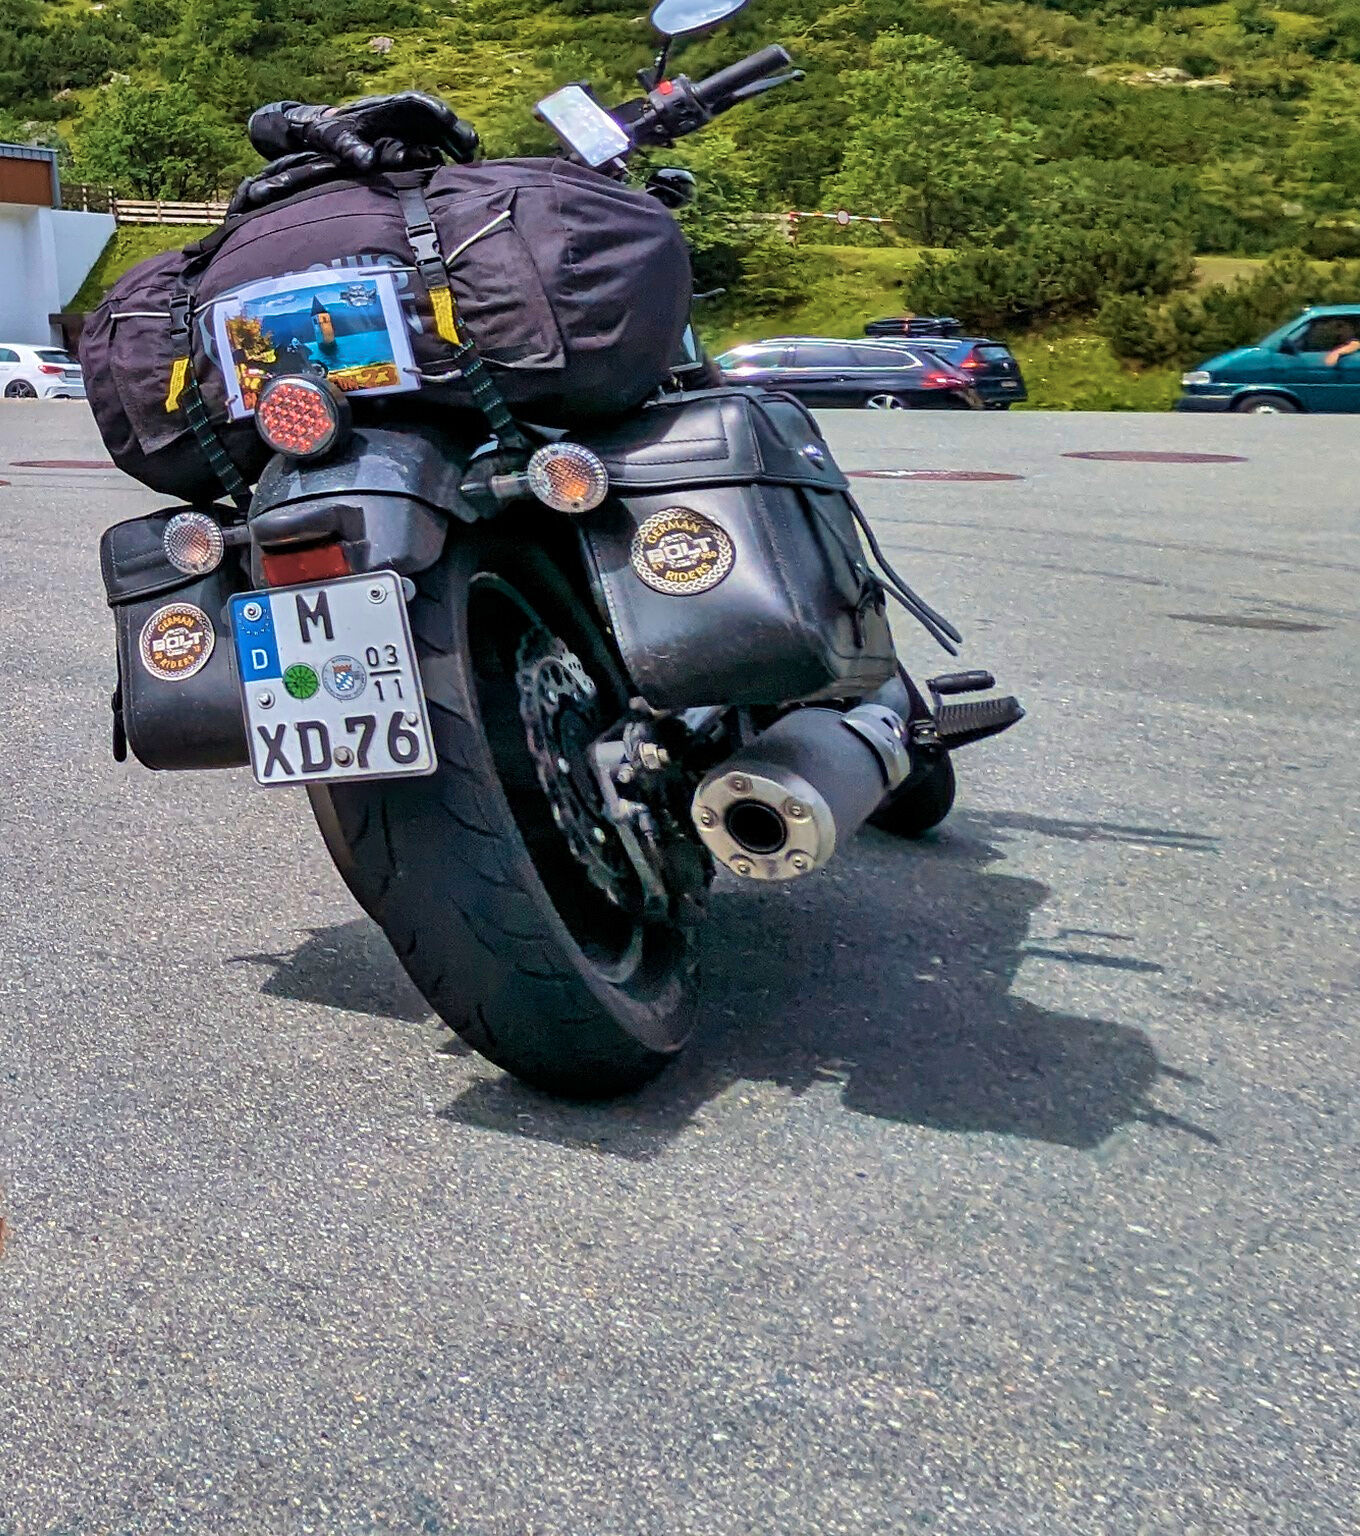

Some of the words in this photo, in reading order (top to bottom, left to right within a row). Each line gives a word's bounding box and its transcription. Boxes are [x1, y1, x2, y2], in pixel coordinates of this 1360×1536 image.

[646, 520, 702, 544] GERMAN
[645, 537, 712, 564] BOLT
[664, 561, 712, 582] RIDERS
[157, 615, 195, 632] GERMAN
[295, 590, 334, 644] M
[152, 632, 204, 653] BOLT
[159, 654, 195, 669] RIDERS
[251, 648, 270, 670] D
[365, 644, 399, 667] 03
[373, 678, 403, 702] 11
